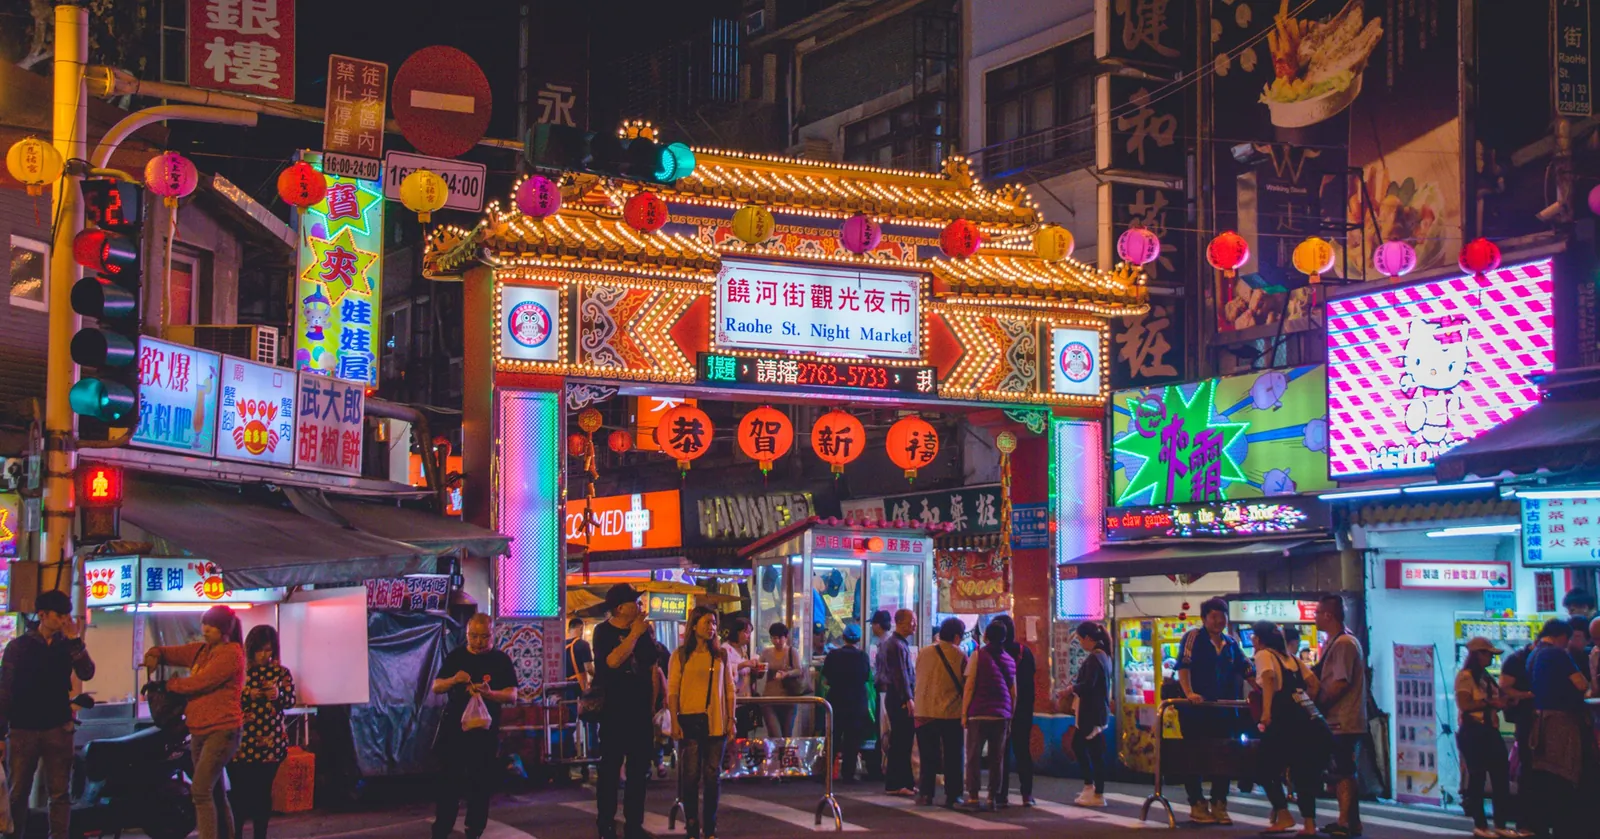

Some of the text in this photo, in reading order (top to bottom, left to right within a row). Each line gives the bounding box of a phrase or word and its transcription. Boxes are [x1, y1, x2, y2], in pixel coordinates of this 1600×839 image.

[1559, 52, 1586, 65] RaoHe
[1559, 68, 1570, 79] St.
[332, 61, 355, 147] 禁止停車
[358, 65, 381, 152] 徒步區內
[538, 83, 577, 127] 永
[326, 156, 378, 178] 16:00-24:00
[726, 277, 912, 316] 饒河街觀光夜市
[340, 299, 371, 382] 娃娃屋
[725, 317, 912, 344] Raohe St. Night Market
[301, 381, 361, 425] 武大郎
[299, 422, 360, 468] 胡椒餅
[668, 417, 936, 462] 恭 賀 新 禧
[1122, 513, 1142, 527] claw
[1144, 512, 1170, 528] games
[1198, 508, 1214, 523] the
[887, 538, 923, 553] 服務台
